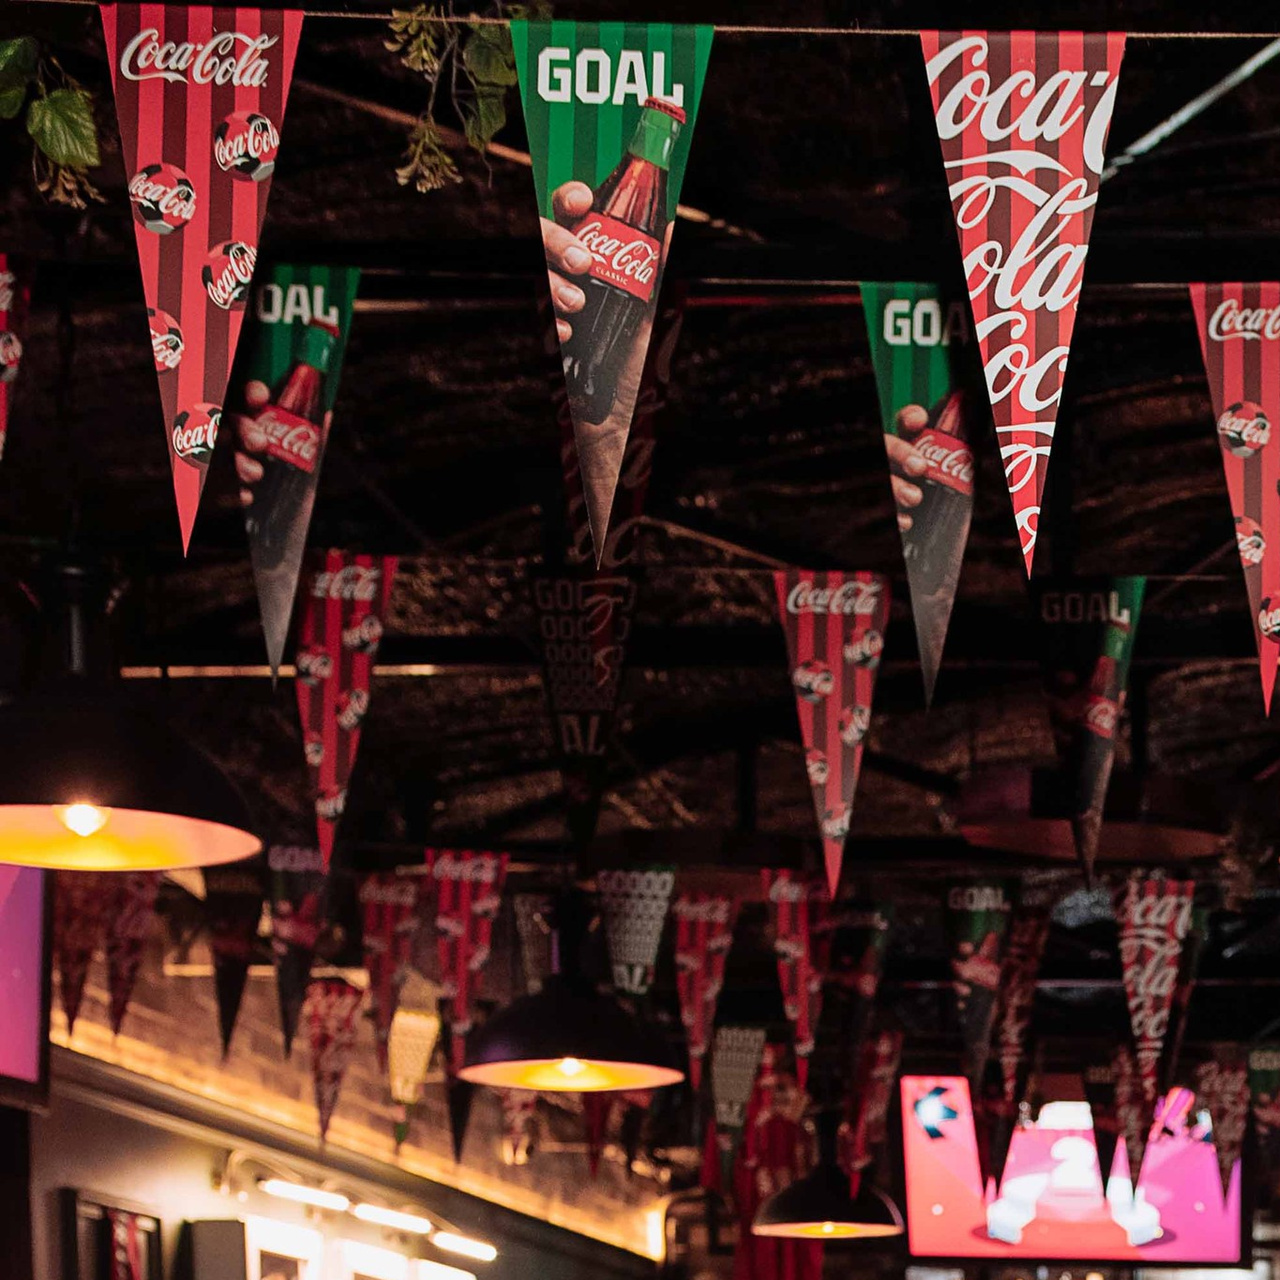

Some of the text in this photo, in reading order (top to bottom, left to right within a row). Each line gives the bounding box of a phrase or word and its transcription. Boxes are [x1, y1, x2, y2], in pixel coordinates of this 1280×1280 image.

[120, 27, 279, 87] Coca-Cola
[537, 47, 684, 106] GOAL
[595, 266, 628, 286] CLASSIC
